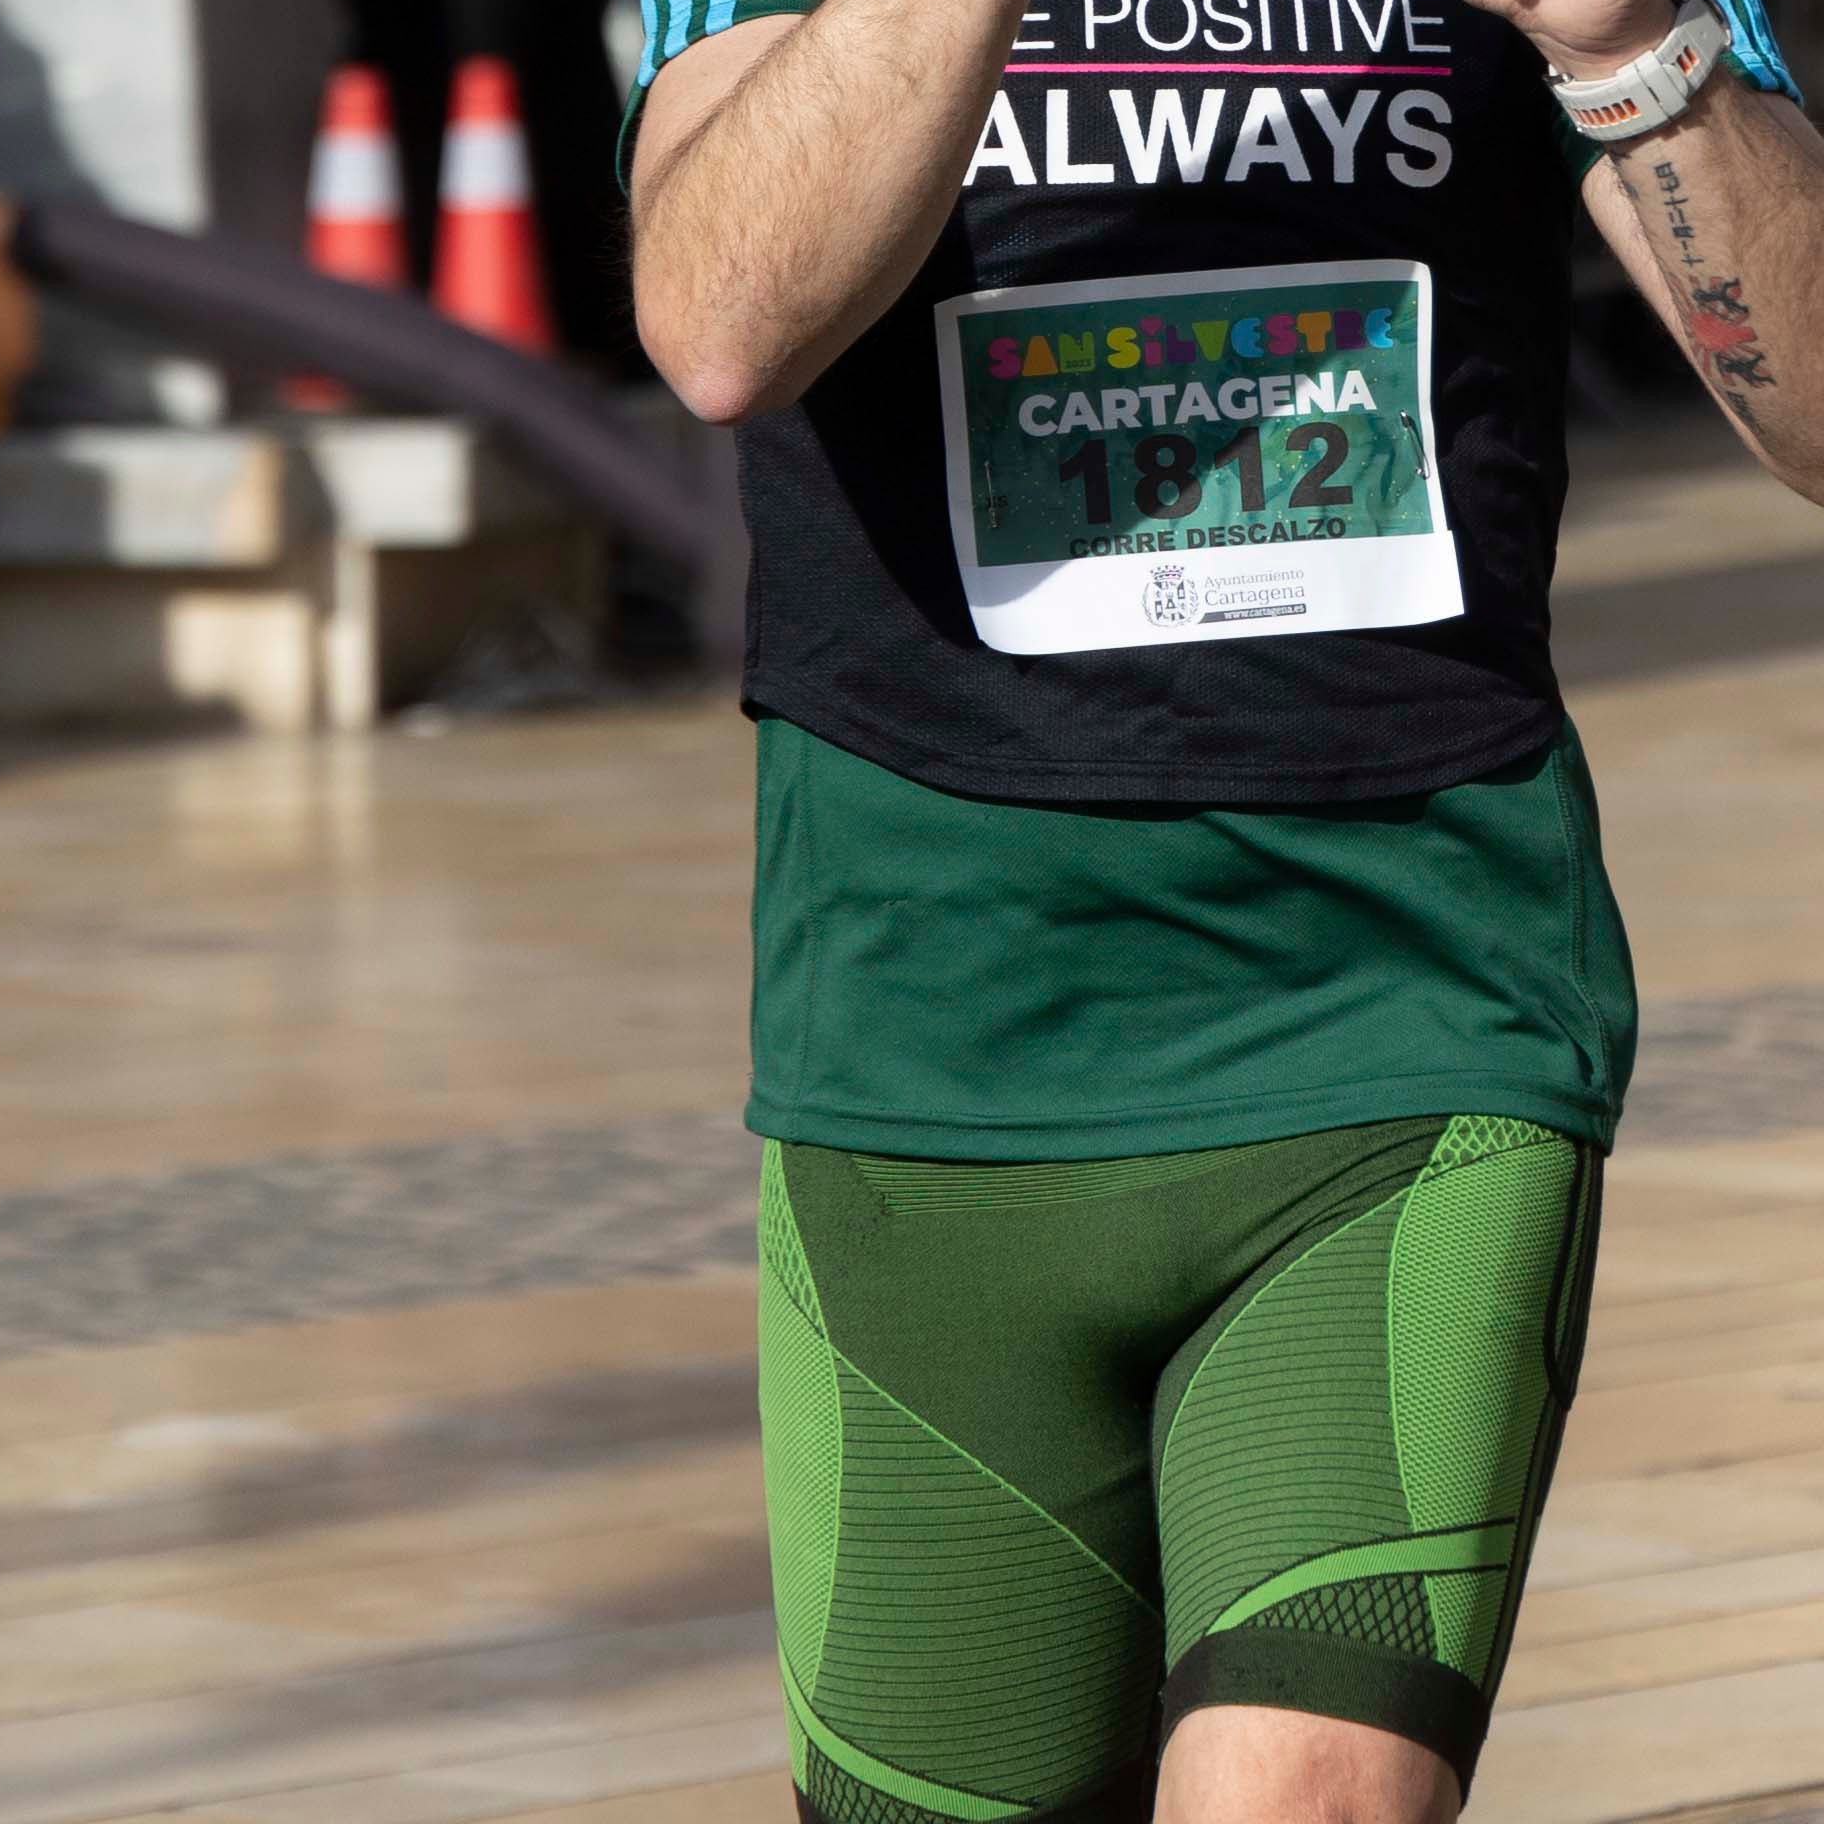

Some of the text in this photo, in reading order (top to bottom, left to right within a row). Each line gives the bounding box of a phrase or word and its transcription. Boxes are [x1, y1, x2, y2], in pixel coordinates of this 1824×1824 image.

[962, 87, 1453, 188] ALWAYS
[987, 329, 1096, 380] SAN
[1017, 369, 1378, 438] CARTAGENA
[1058, 421, 1354, 526] 1812
[1069, 516, 1347, 558] CORRE DESCALZO
[1204, 569, 1305, 590] Ayuntamiento
[1204, 584, 1306, 608] Cartagena
[1223, 603, 1305, 621] www.cartagena.es
